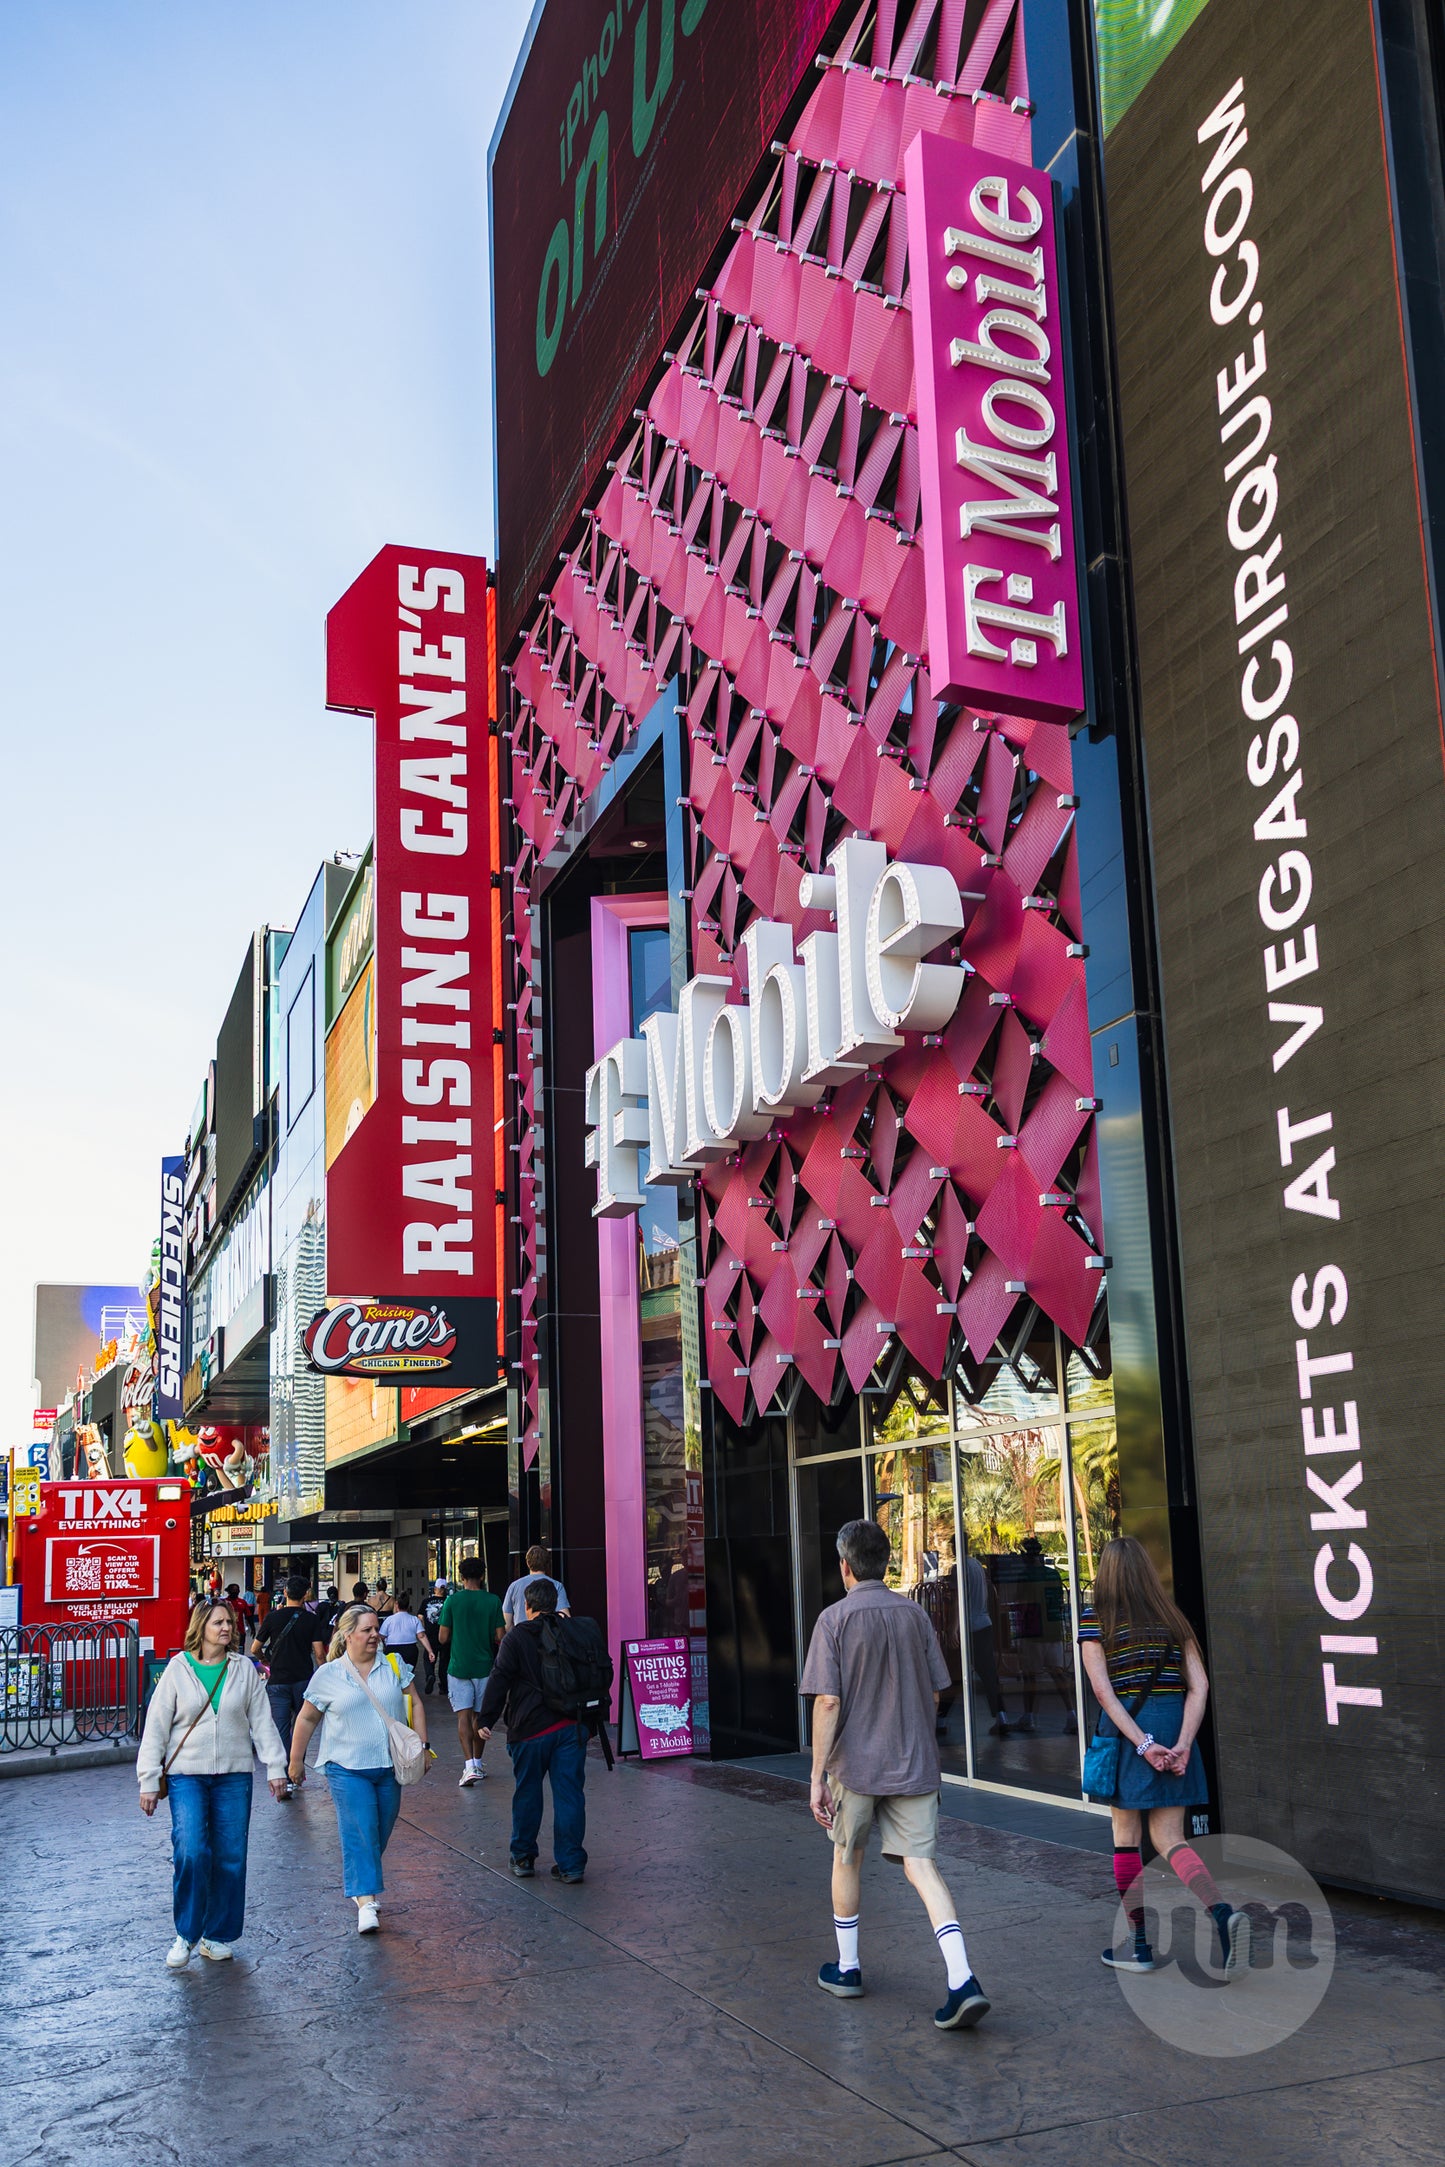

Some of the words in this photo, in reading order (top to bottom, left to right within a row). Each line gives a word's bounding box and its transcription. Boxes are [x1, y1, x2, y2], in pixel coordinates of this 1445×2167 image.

[536, 109, 609, 378] on
[631, 0, 708, 158] u
[1198, 76, 1324, 1073] VEGASCIRQUE.COM
[398, 564, 468, 857] CANE'S
[400, 891, 474, 1276] RAISING
[1277, 1106, 1342, 1221] AT
[159, 1173, 184, 1401] SKECHERS
[312, 1303, 456, 1368] Cane's
[364, 1306, 415, 1321] Raising
[361, 1359, 400, 1368] CHICKEN
[403, 1358, 443, 1367] FINGERS
[58, 1489, 147, 1519] TIX4
[1291, 1263, 1383, 1726] TICKETS
[73, 1609, 109, 1617] TICKETS
[104, 1602, 138, 1610] MILLION
[633, 1655, 685, 1671] VISITING
[635, 1670, 659, 1683] THE
[660, 1666, 687, 1681] U.S.?
[646, 1683, 655, 1691] Get
